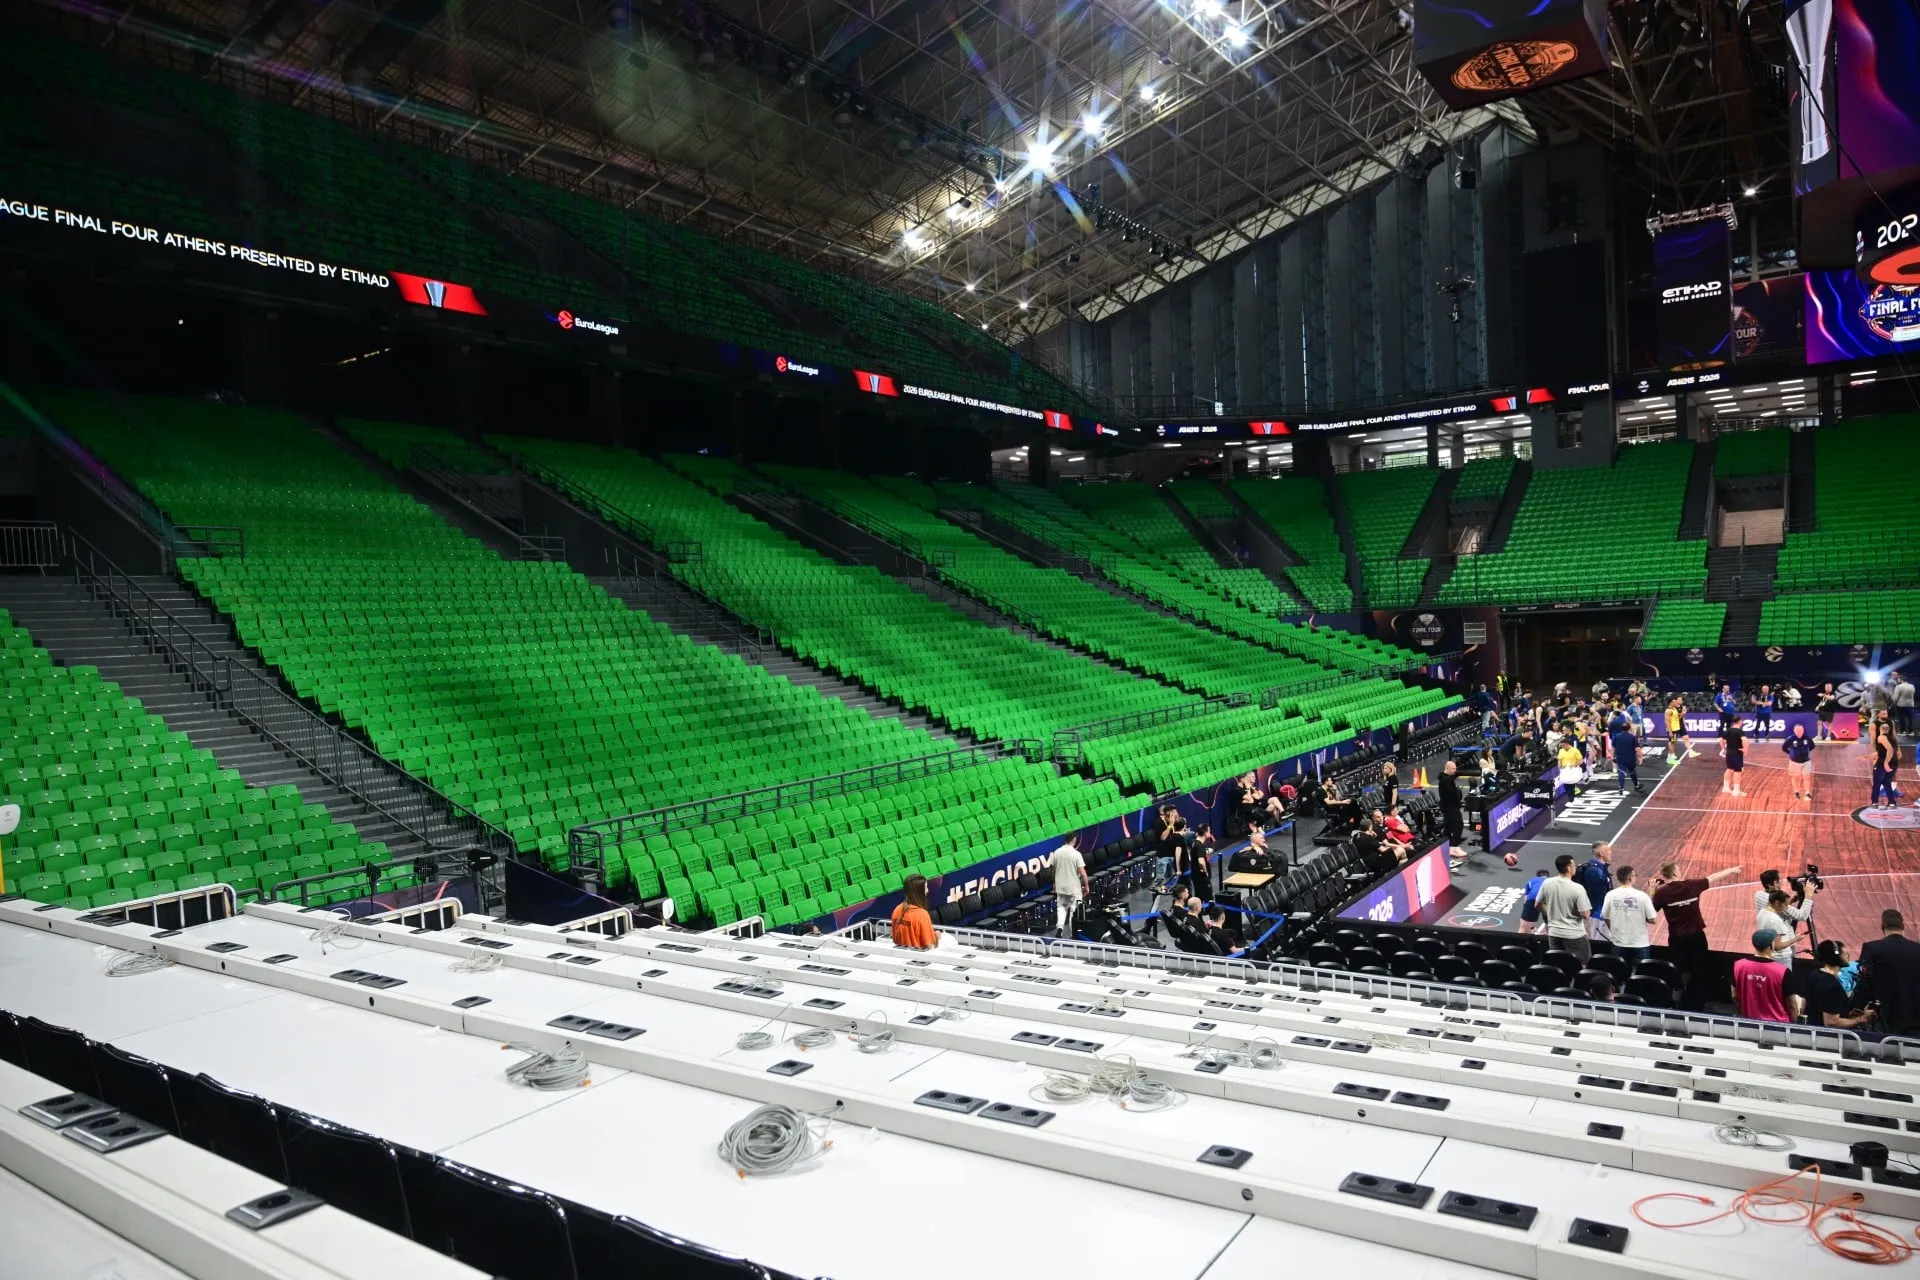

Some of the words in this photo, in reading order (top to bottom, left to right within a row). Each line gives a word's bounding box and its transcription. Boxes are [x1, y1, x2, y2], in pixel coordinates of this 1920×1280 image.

[0, 198, 49, 221] AGUE
[55, 209, 106, 232] FINAL
[112, 221, 159, 243] FOUR
[164, 232, 226, 256] ATHENS
[231, 245, 315, 273] PRESENTED
[319, 263, 337, 278] BY
[342, 268, 389, 288] ETIHAD
[1662, 281, 1722, 298] ETIHAD
[1869, 300, 1908, 317] FINAL
[1911, 298, 1920, 311] F
[575, 317, 619, 335] EuroLeague
[1736, 328, 1757, 339] OUR
[1567, 386, 1588, 395] FINAL
[1588, 382, 1610, 392] FOUR
[965, 397, 979, 407] FOUR
[1366, 416, 1383, 424] FOUR
[1442, 407, 1452, 415] BY
[1452, 404, 1477, 413] ETIHAD
[1555, 789, 1628, 826] ATHENS
